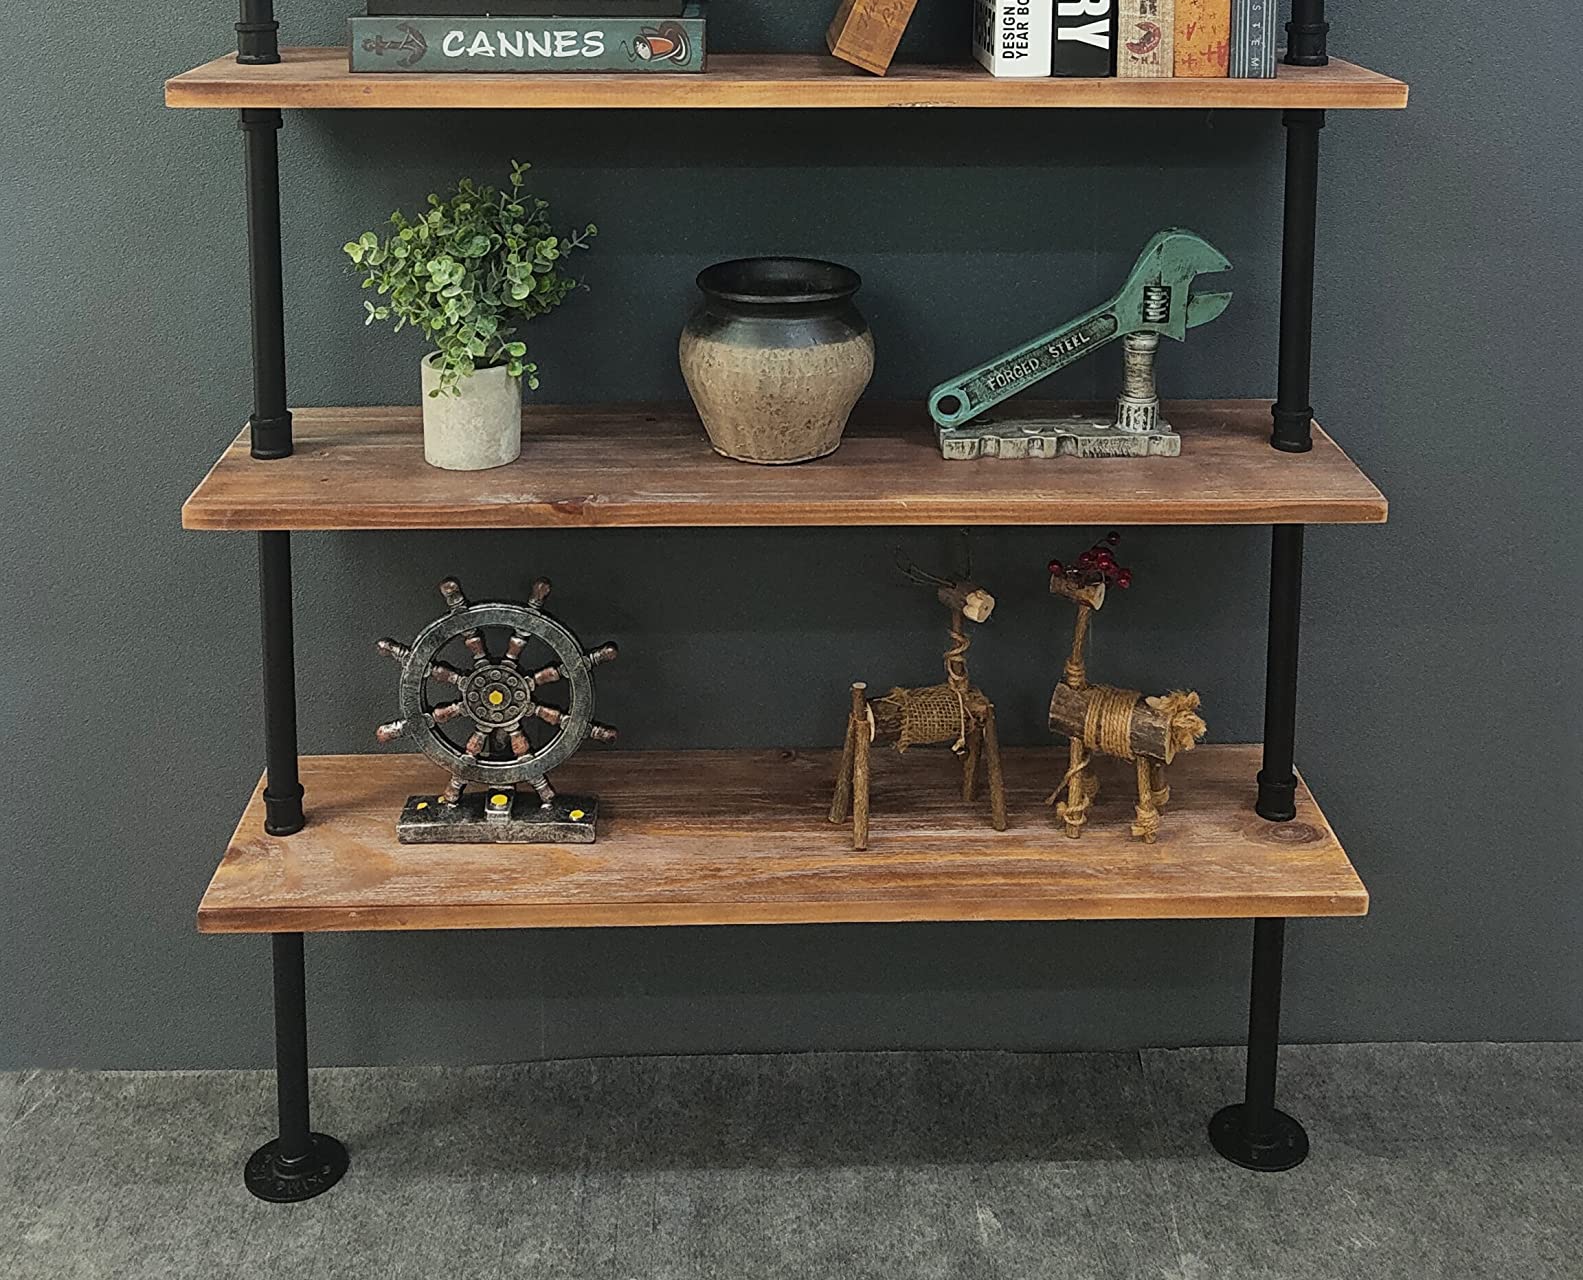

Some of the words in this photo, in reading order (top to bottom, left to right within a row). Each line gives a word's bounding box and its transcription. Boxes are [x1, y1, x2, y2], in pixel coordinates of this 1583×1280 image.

[442, 30, 605, 58] CANNES
[1002, 6, 1016, 59] DESIGN
[1015, 21, 1029, 60] YEAR
[987, 357, 1040, 391] FORGED
[1049, 331, 1090, 358] STEEL
